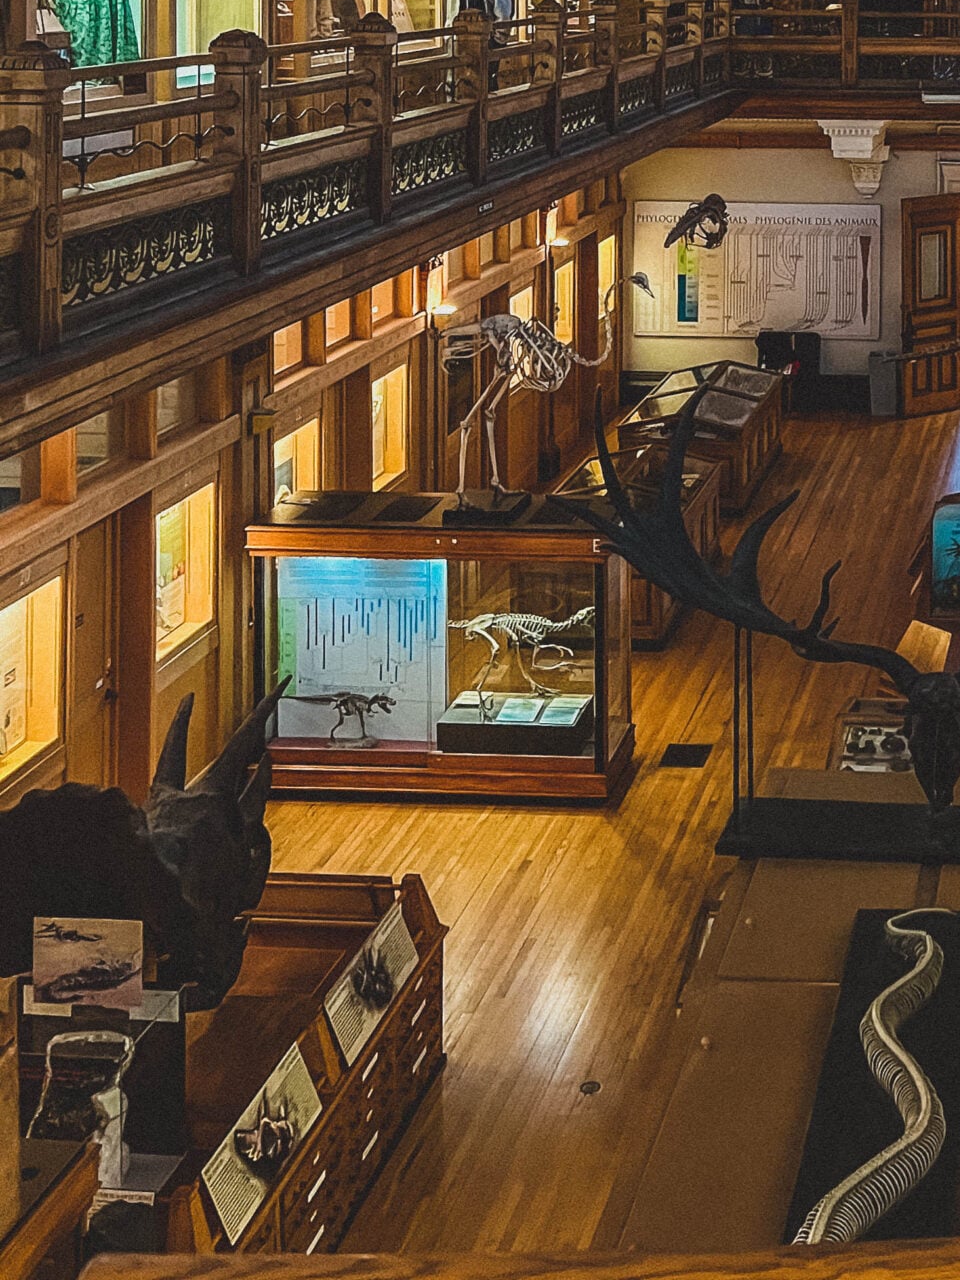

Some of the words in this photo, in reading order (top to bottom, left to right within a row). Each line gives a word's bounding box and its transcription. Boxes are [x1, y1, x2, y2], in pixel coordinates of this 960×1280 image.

[815, 217, 831, 226] DES
[834, 217, 878, 226] ANIMAUX
[593, 539, 600, 552] E
